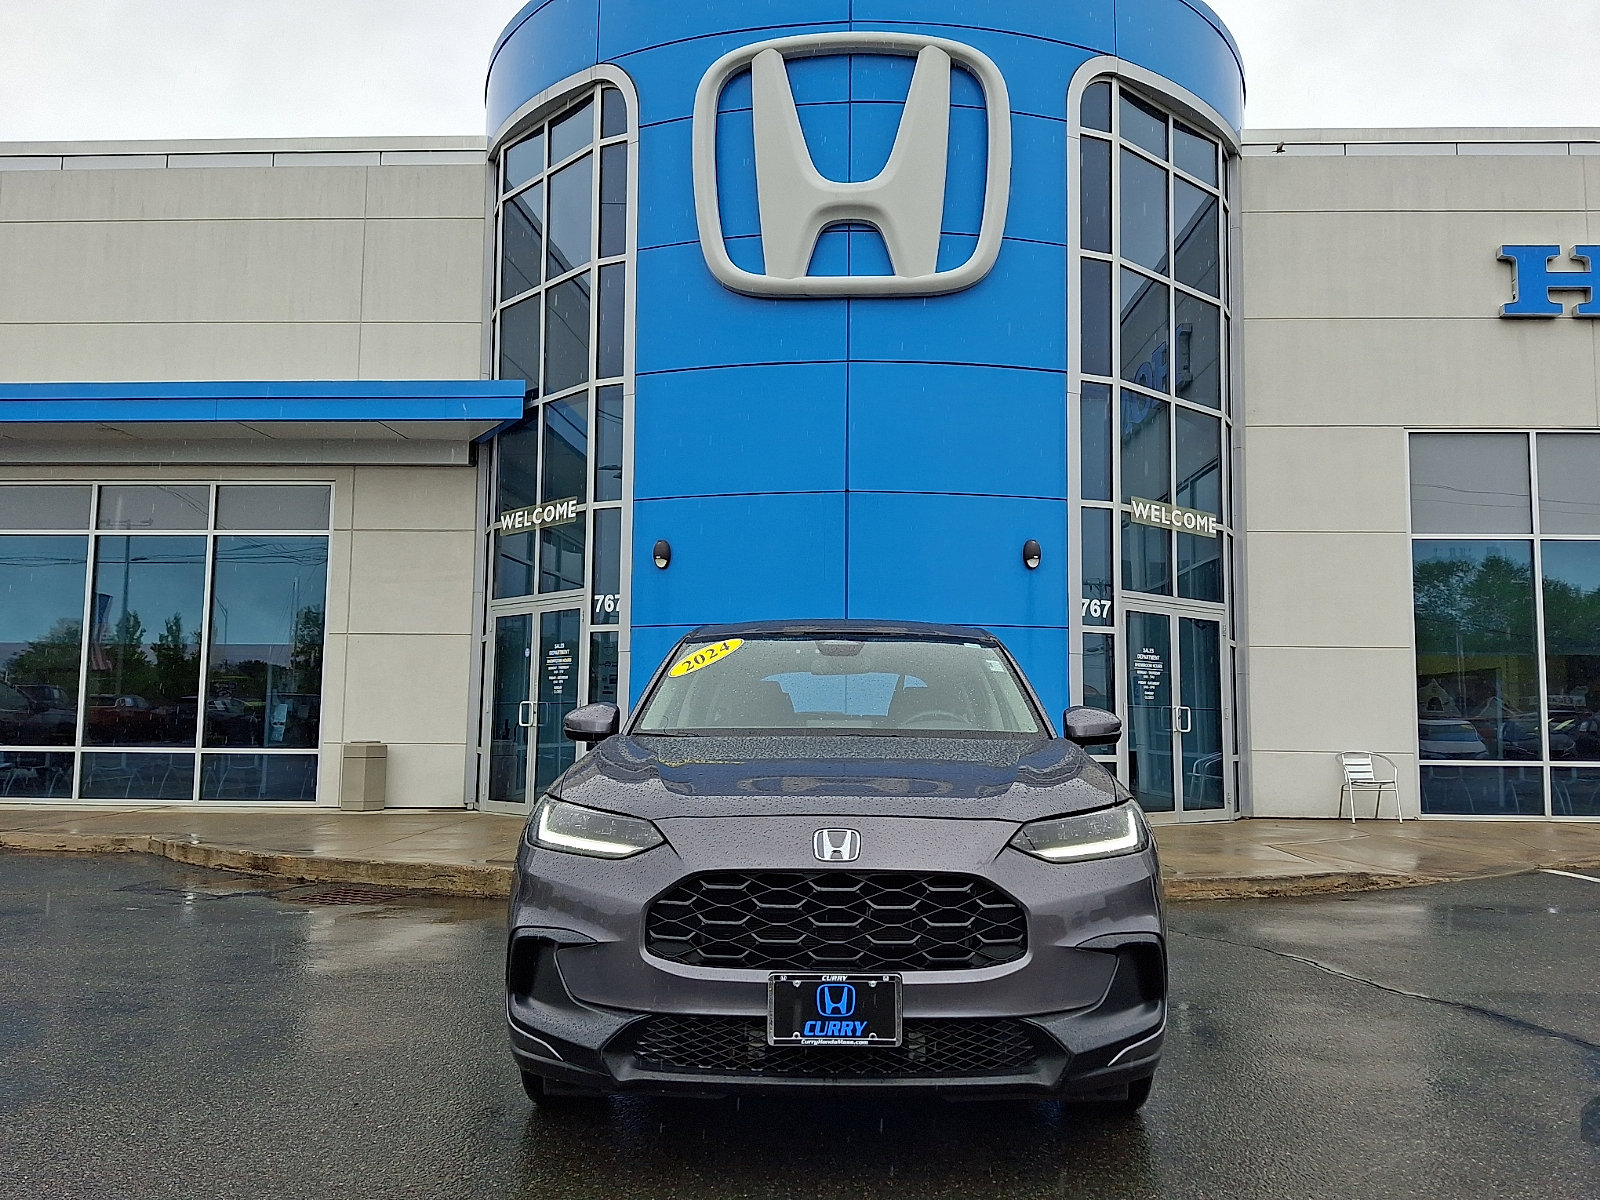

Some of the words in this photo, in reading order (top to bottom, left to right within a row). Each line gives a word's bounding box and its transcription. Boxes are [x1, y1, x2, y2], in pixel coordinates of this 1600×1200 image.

[500, 499, 578, 531] WELCOME
[1130, 500, 1217, 534] WELCOME
[1081, 598, 1112, 618] 767
[681, 641, 730, 672] 2024
[803, 1020, 868, 1037] CURRY
